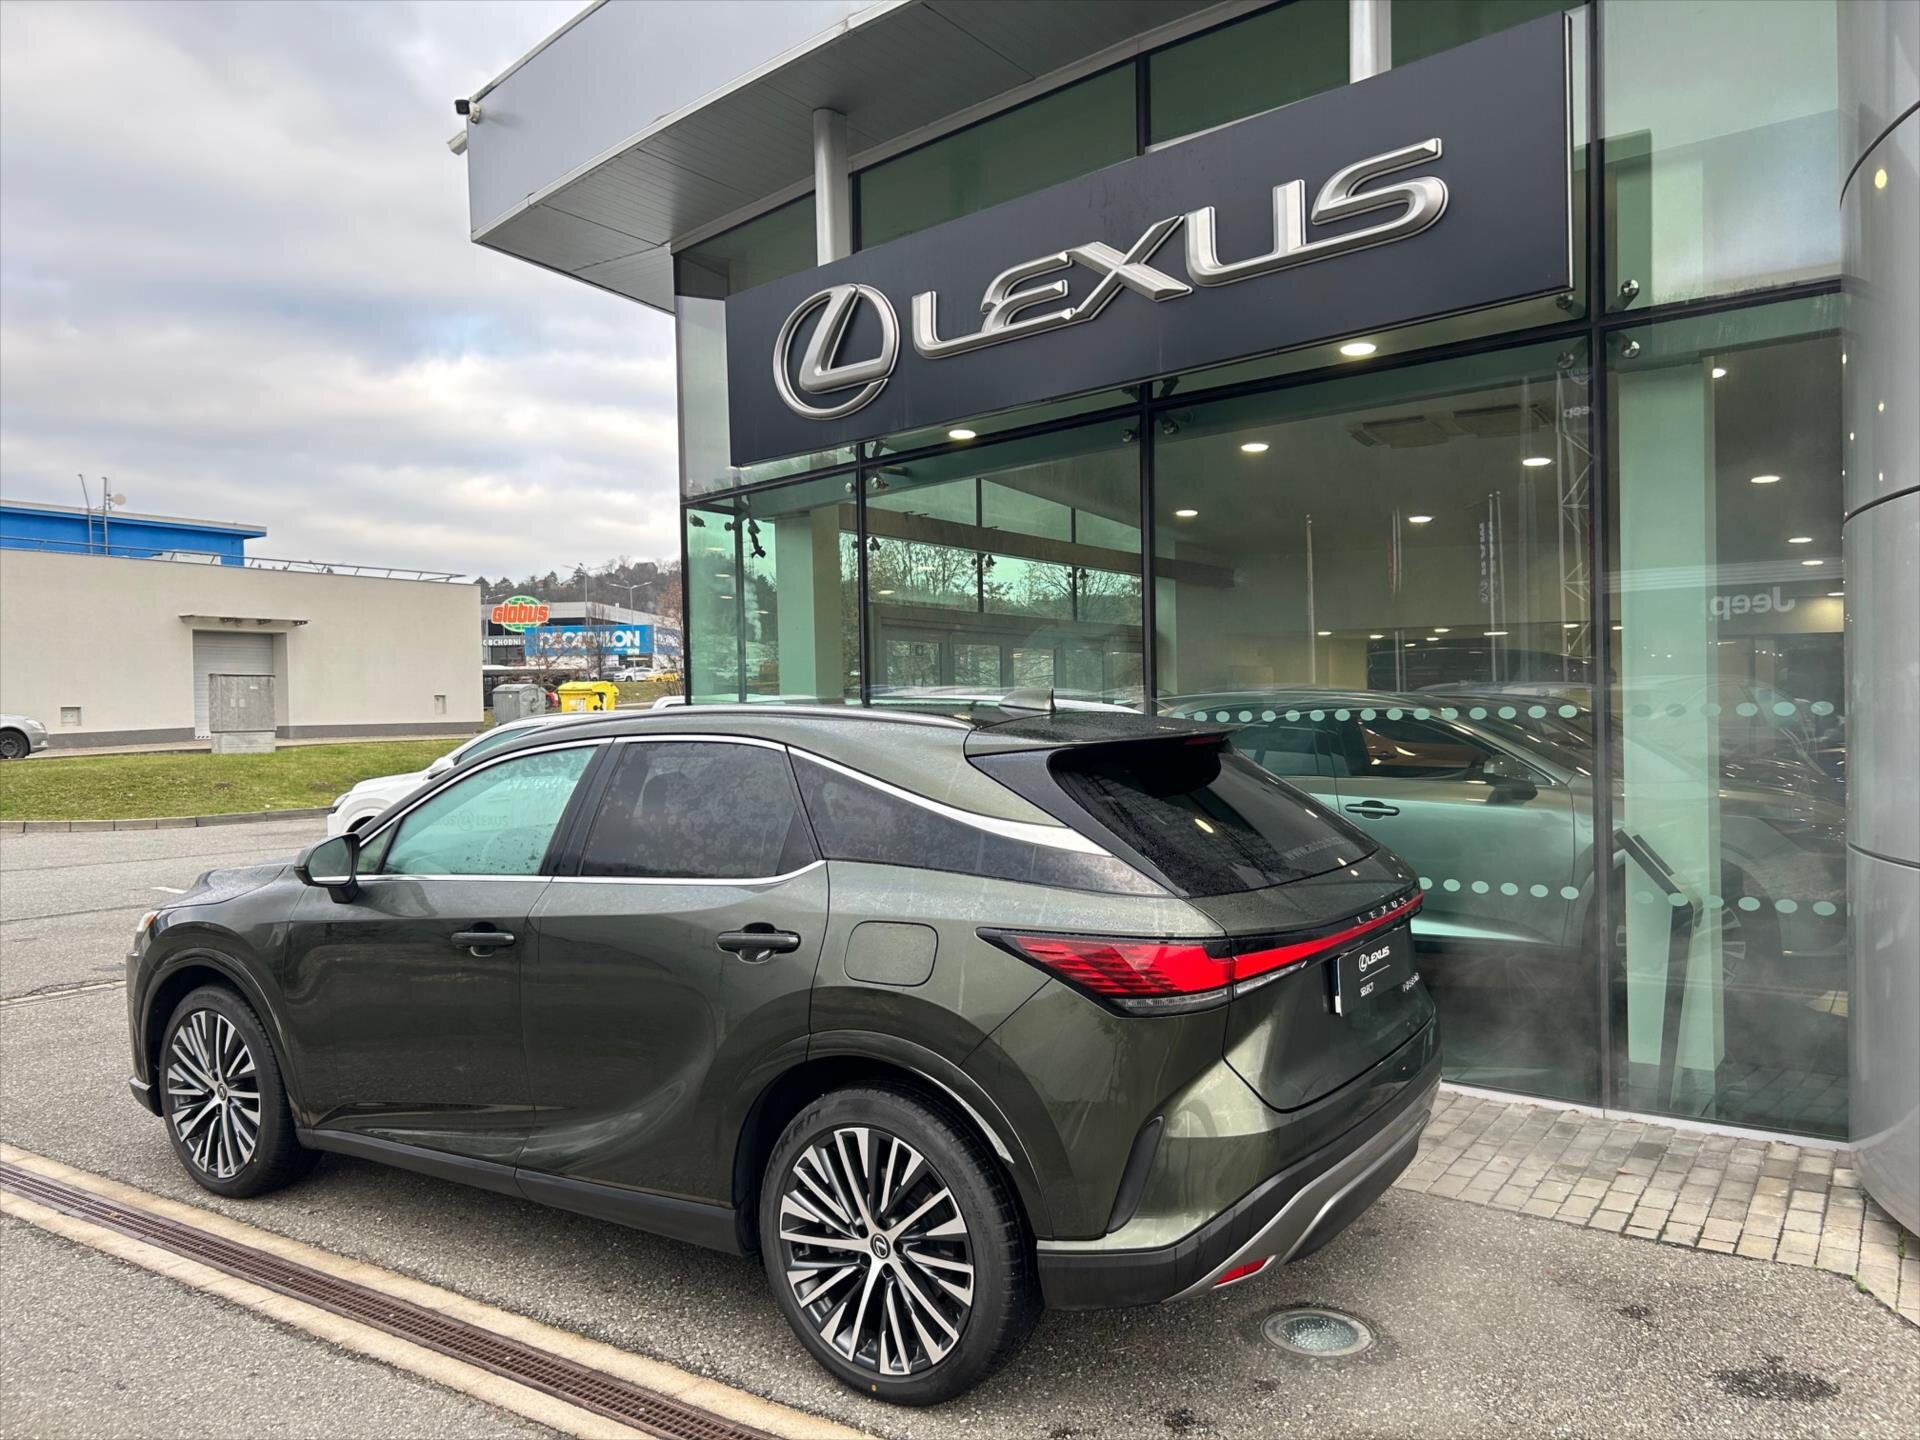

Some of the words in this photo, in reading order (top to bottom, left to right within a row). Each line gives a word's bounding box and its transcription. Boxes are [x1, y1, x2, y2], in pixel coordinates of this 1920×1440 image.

[911, 137, 1450, 360] LEXUS
[1357, 898, 1407, 923] LEXUS
[1366, 946, 1390, 964] LEXUS
